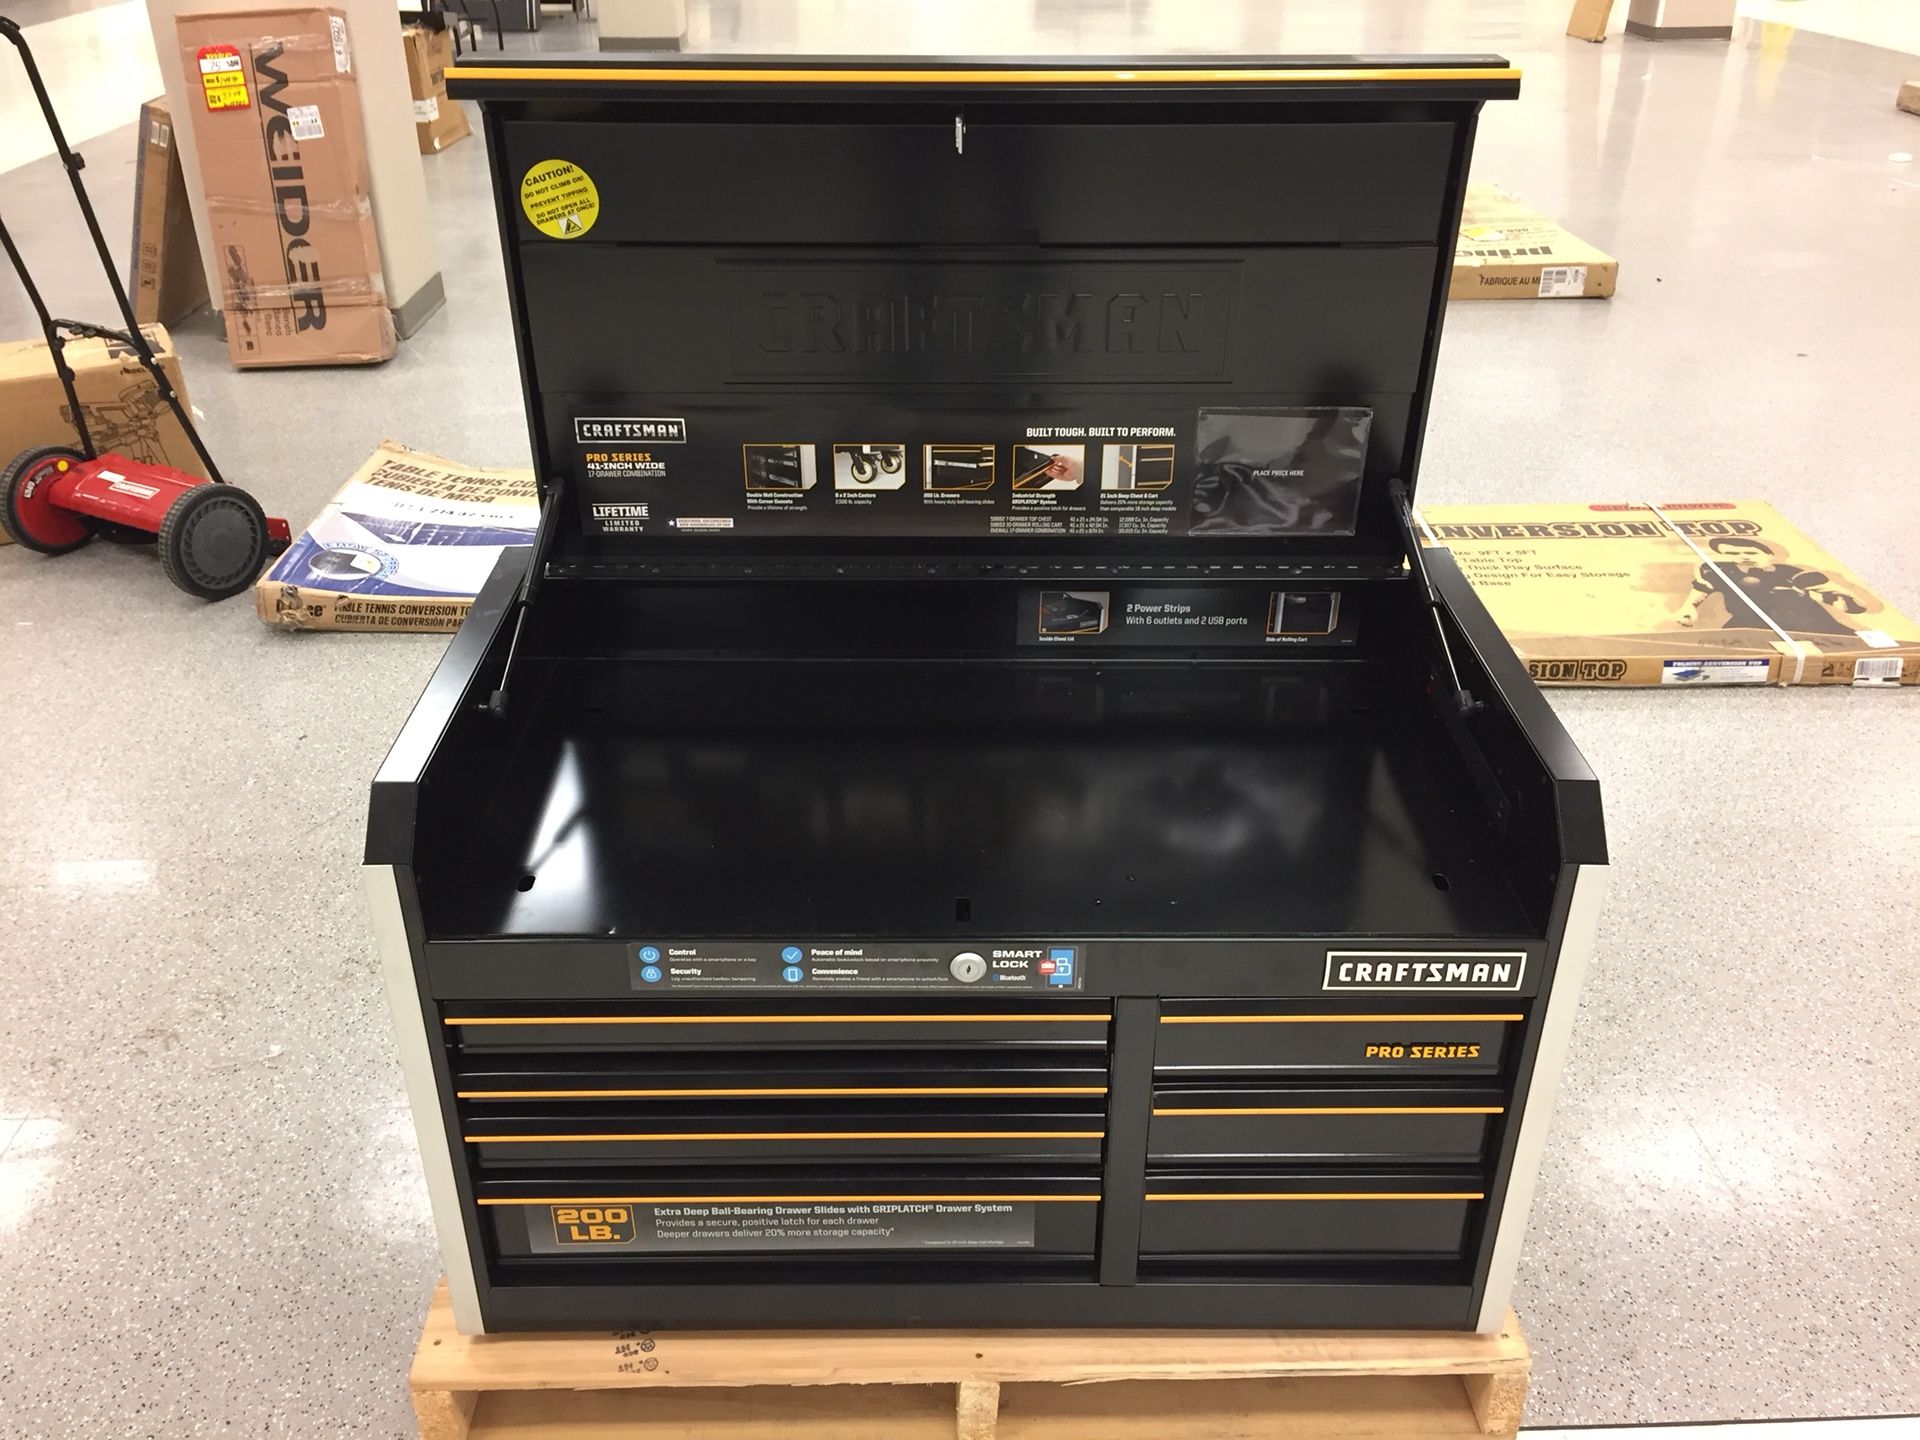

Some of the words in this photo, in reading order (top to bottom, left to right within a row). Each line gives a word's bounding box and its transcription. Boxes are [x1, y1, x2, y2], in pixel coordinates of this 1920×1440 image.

[525, 165, 575, 187] CAUTION!
[254, 41, 327, 332] WEIDER
[524, 191, 535, 199] DO
[535, 186, 549, 195] NOT
[550, 180, 572, 190] CLIMB
[530, 195, 560, 209] PREVENT
[561, 186, 588, 199] TIPPING
[546, 207, 560, 215] NOT
[560, 201, 578, 210] OPEN
[579, 197, 591, 206] ALL
[536, 212, 567, 225] DRAWERS
[567, 208, 575, 216] AT
[1480, 276, 1518, 286] FABRIQUE
[1519, 276, 1530, 285] AU
[757, 293, 1207, 353] CRAFTSMAN
[582, 424, 679, 438] CRAFTSMAN
[1026, 427, 1053, 437] BUILT
[1054, 427, 1087, 437] TOUGH.
[1088, 427, 1115, 437] BUILT
[1116, 426, 1129, 437] TO
[1129, 426, 1176, 437] PERFORM.
[586, 453, 608, 462] PRO
[611, 453, 652, 462] SERIES
[383, 459, 439, 478] TABLE
[442, 473, 504, 487] TENNIS
[587, 462, 633, 470] 41-INCH
[634, 462, 666, 470] WIDE
[588, 470, 622, 478] 17-DRAWER
[622, 469, 666, 478] COMBINATION
[371, 468, 457, 490] CUBIERTA
[462, 485, 484, 494] DE
[366, 477, 416, 492] TENIS
[416, 488, 441, 498] DE
[441, 492, 496, 504] MESA
[592, 506, 649, 517] LIFETIME
[1664, 521, 1761, 537] TOP
[1473, 572, 1518, 580] Design
[365, 603, 396, 616] TENNIS
[398, 604, 458, 618] CONVERSION
[1126, 604, 1133, 613] 2
[1134, 604, 1162, 613] Power
[1163, 604, 1191, 615] Strips
[335, 614, 376, 626] CUBIERTA
[378, 615, 389, 626] DE
[1126, 616, 1145, 625] With
[1146, 616, 1152, 625] 6
[1153, 616, 1183, 625] outlets
[1183, 616, 1200, 625] and
[1200, 616, 1207, 625] 2
[1207, 616, 1225, 625] USB
[1225, 617, 1248, 627] ports
[1582, 659, 1628, 682] TOP
[668, 948, 697, 956] Control
[992, 950, 1043, 958] SMART
[992, 960, 1029, 969] LOCK
[670, 968, 702, 976] Security
[1338, 963, 1511, 982] CRAFTSMAN
[1365, 1045, 1405, 1058] PRO
[1410, 1045, 1481, 1058] SERIES
[557, 1208, 628, 1224] 200
[654, 1207, 682, 1216] Extra
[683, 1207, 709, 1217] Deep
[711, 1206, 774, 1217] Ball-Bearing
[775, 1205, 812, 1215] Drawer
[814, 1205, 845, 1214] Slides
[847, 1205, 871, 1214] with
[935, 1203, 972, 1213] Drawer
[974, 1203, 1013, 1214] System
[655, 1218, 696, 1228] Provides
[705, 1219, 741, 1228] secure,
[742, 1217, 779, 1228] positive
[781, 1217, 805, 1226] latch
[807, 1216, 821, 1225] for
[822, 1216, 845, 1225] each
[846, 1216, 879, 1225] drawer
[570, 1225, 621, 1240] LB.
[657, 1229, 693, 1239] Deeper
[694, 1229, 730, 1238] drawers
[732, 1228, 763, 1238] deliver
[765, 1228, 786, 1238] 20%
[787, 1229, 812, 1237] more
[813, 1228, 849, 1239] storage
